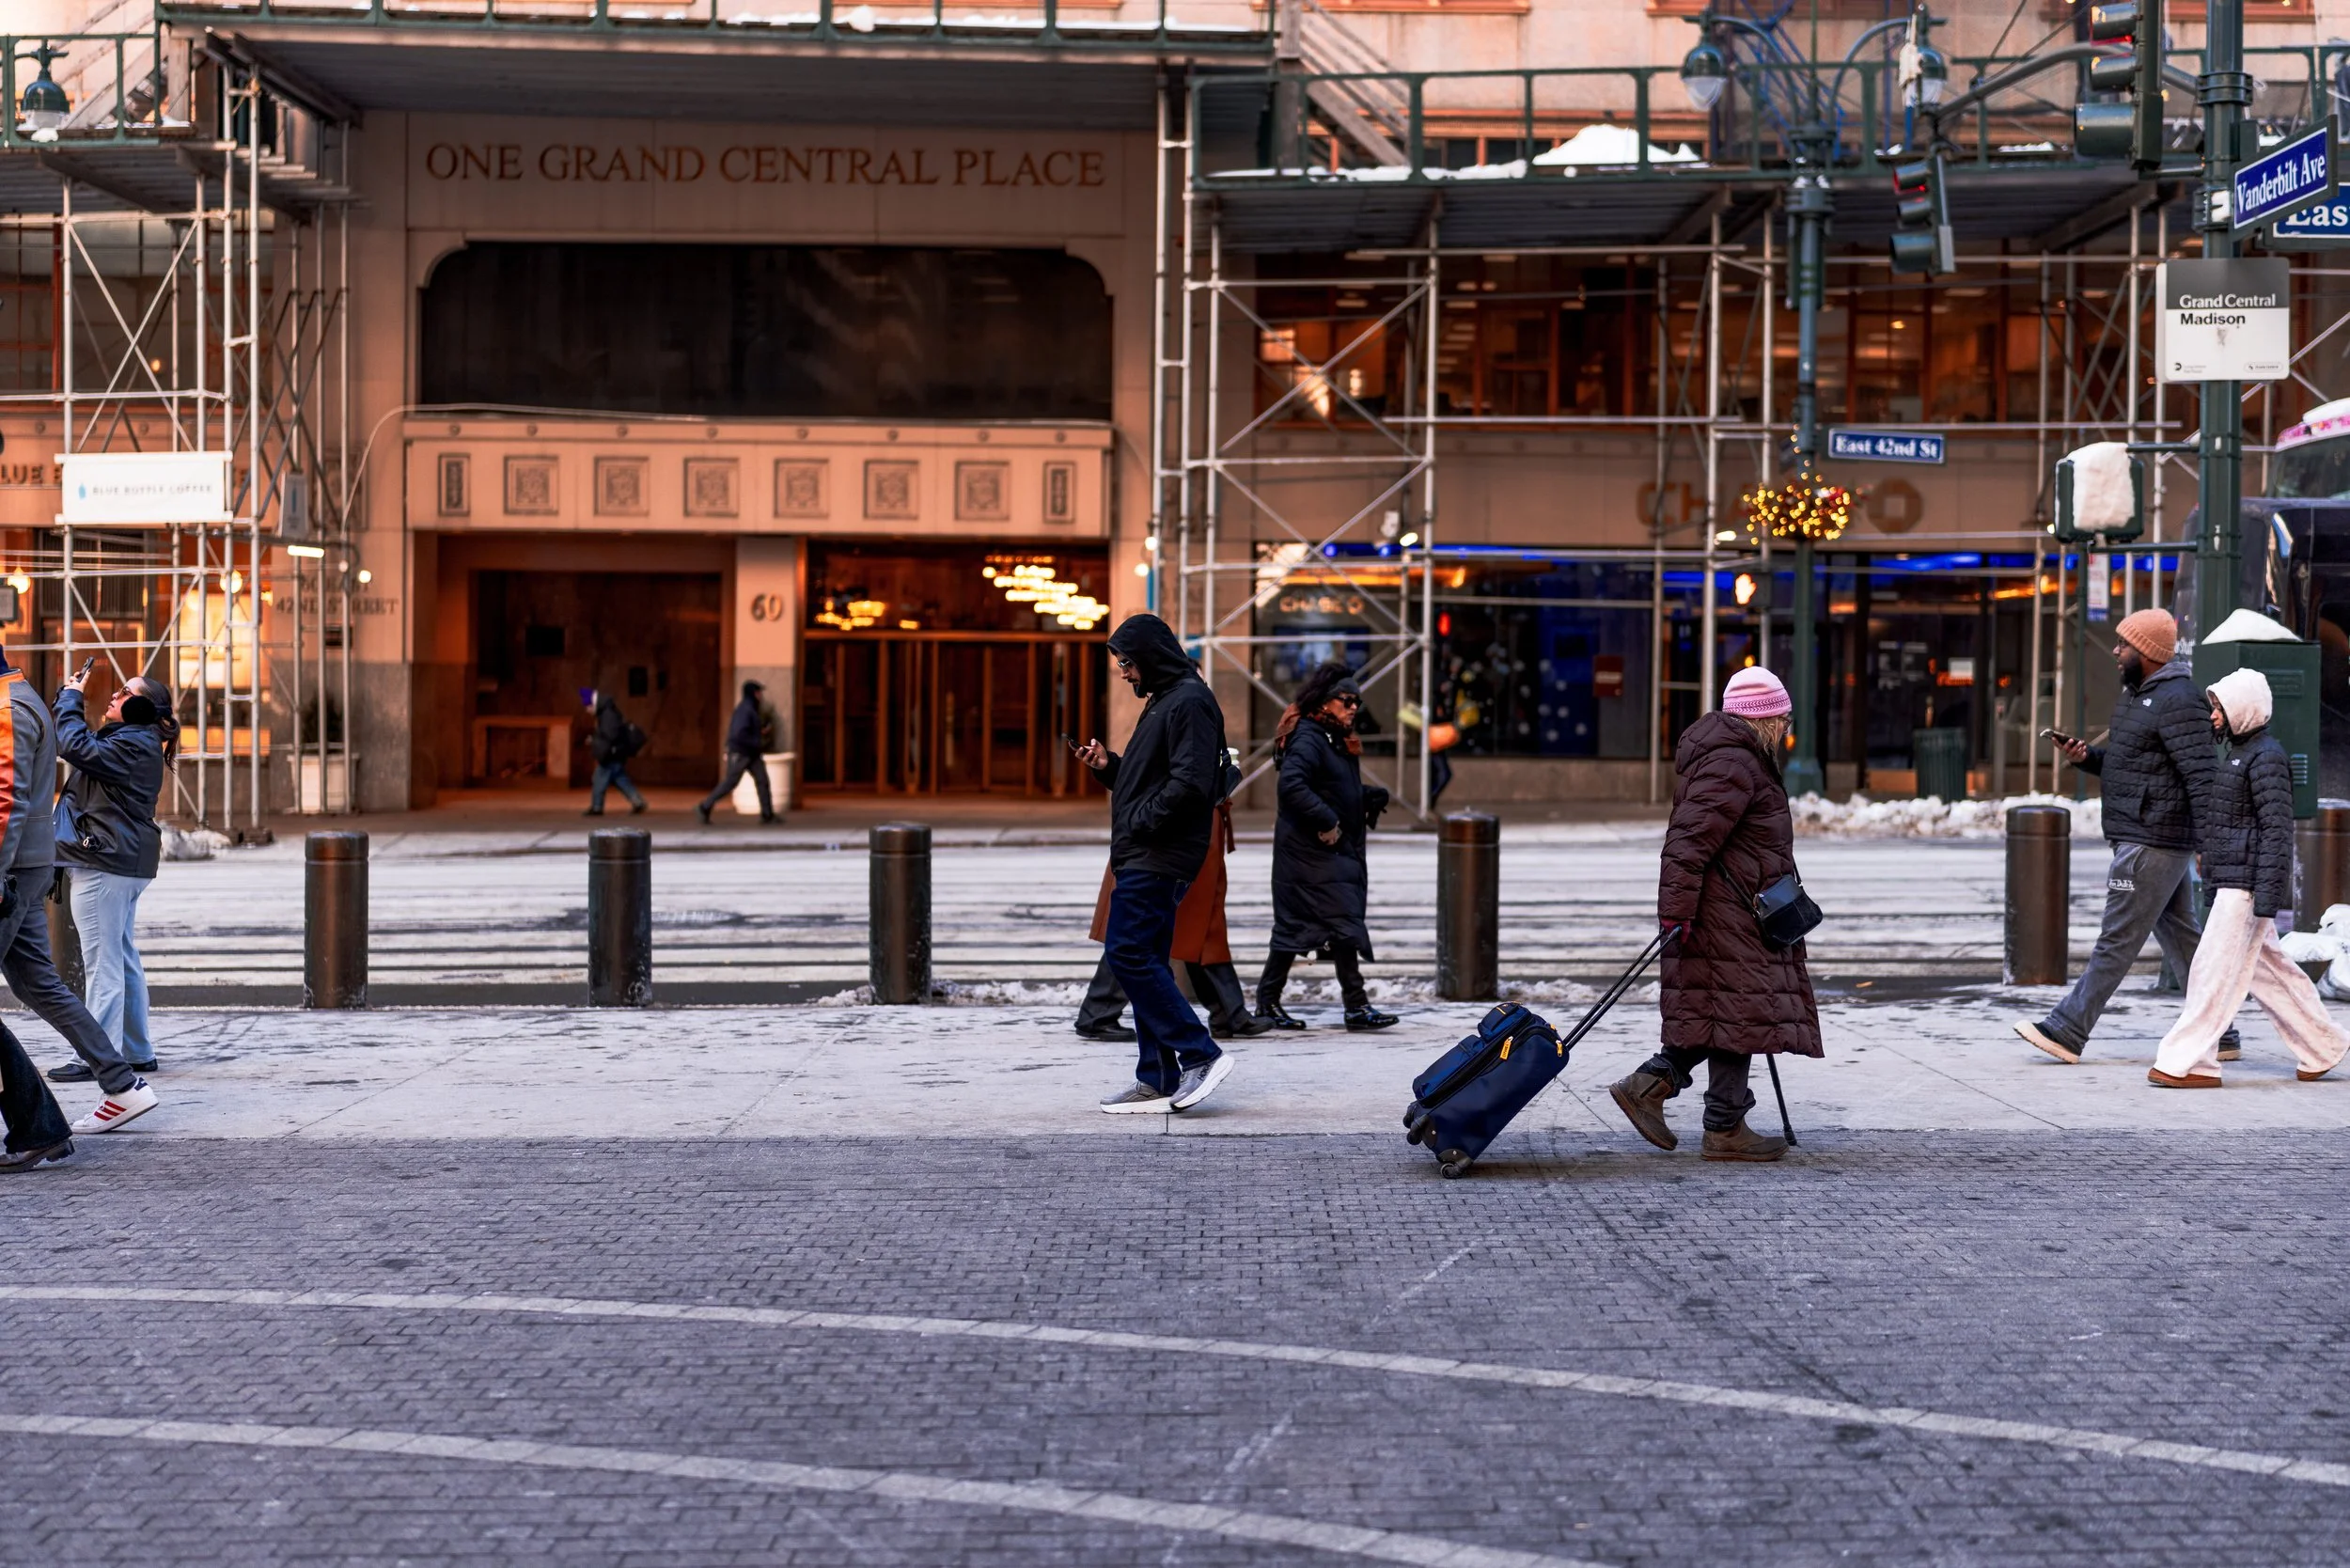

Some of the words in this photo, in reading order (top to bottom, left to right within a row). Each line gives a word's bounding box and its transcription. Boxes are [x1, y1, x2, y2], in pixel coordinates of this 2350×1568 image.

[426, 143, 524, 180] ONE
[538, 144, 705, 182] GRAND
[718, 146, 940, 185] CENTRAL
[952, 149, 1107, 187] PLACE
[2236, 159, 2298, 214] Vanderbilt
[2300, 152, 2326, 187] Ave
[2285, 205, 2350, 227] Eas
[2179, 293, 2223, 309] Grand
[2224, 293, 2276, 308] Central
[2180, 312, 2246, 325] Madison
[1836, 435, 1872, 454] East
[1874, 436, 1916, 457] 42nd
[1919, 439, 1937, 459] St
[750, 592, 783, 622] 60
